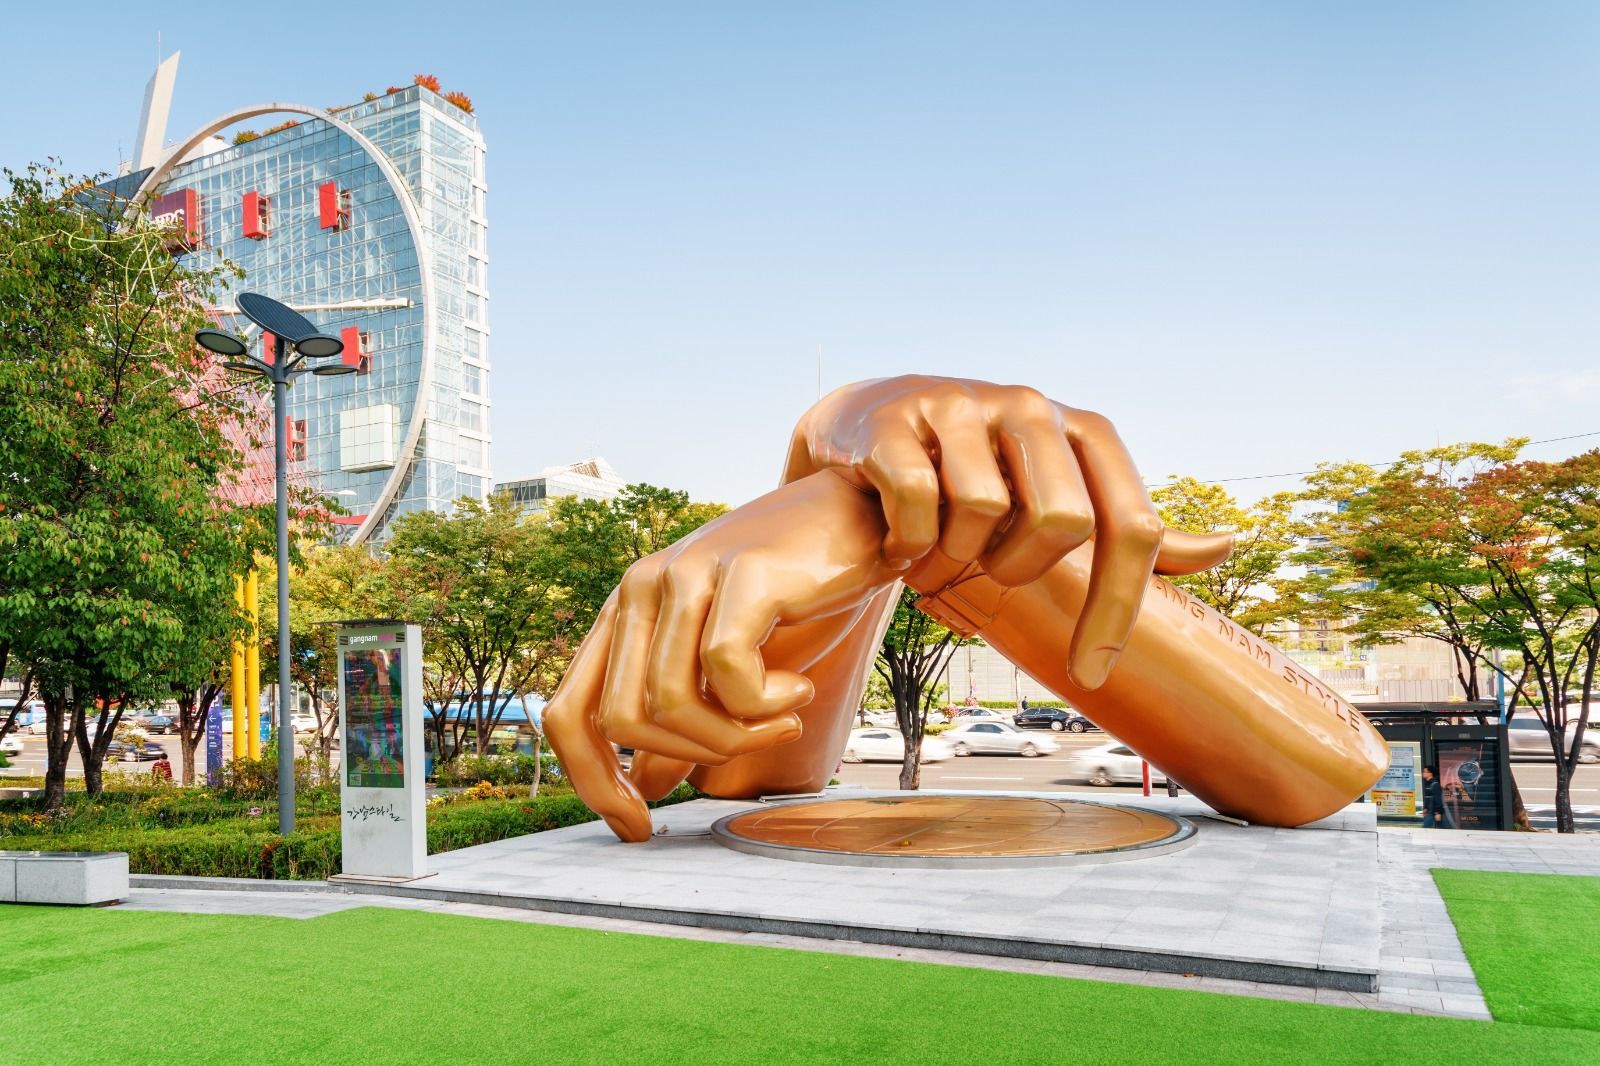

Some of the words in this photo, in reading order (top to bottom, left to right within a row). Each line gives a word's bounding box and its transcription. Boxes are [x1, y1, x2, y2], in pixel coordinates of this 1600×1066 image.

[350, 635, 377, 645] gangnam
[1153, 578, 1205, 621] ANG
[1218, 618, 1271, 668] NAM
[1283, 666, 1360, 732] STYLE
